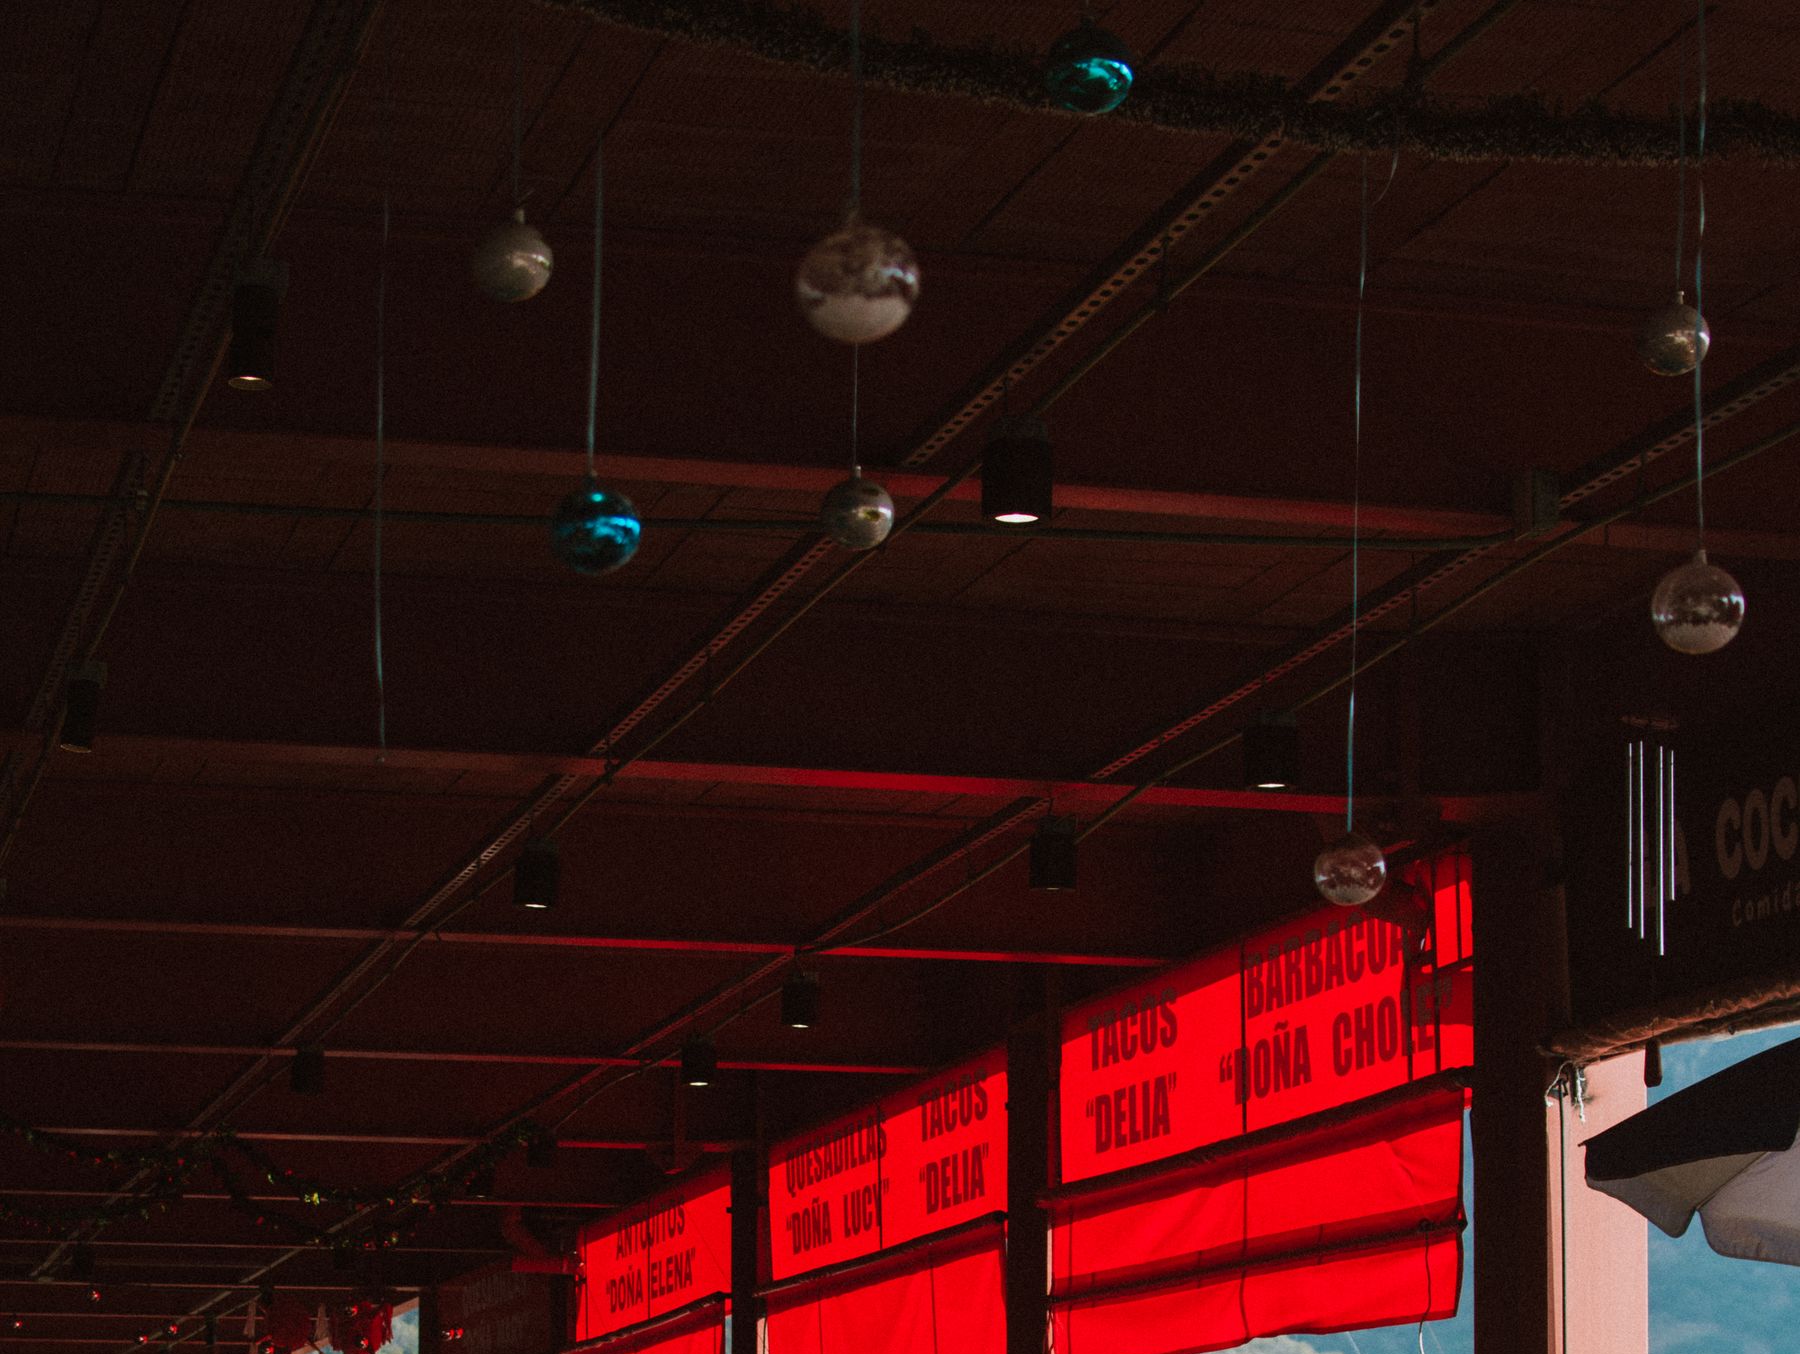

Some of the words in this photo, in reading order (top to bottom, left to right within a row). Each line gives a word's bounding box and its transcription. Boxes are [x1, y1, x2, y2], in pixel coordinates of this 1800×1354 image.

[1088, 987, 1177, 1071] TACOS
[1218, 1021, 1312, 1105] "DOÑA
[918, 1067, 988, 1142] TACOS
[1085, 1072, 1177, 1154] "DELIA"
[785, 1114, 887, 1197] QUESADILLAS
[919, 1142, 989, 1215] "DELIA"
[786, 1197, 832, 1255] "DOÑA
[843, 1177, 889, 1238] LUCY"
[650, 1245, 696, 1300] ELENA"
